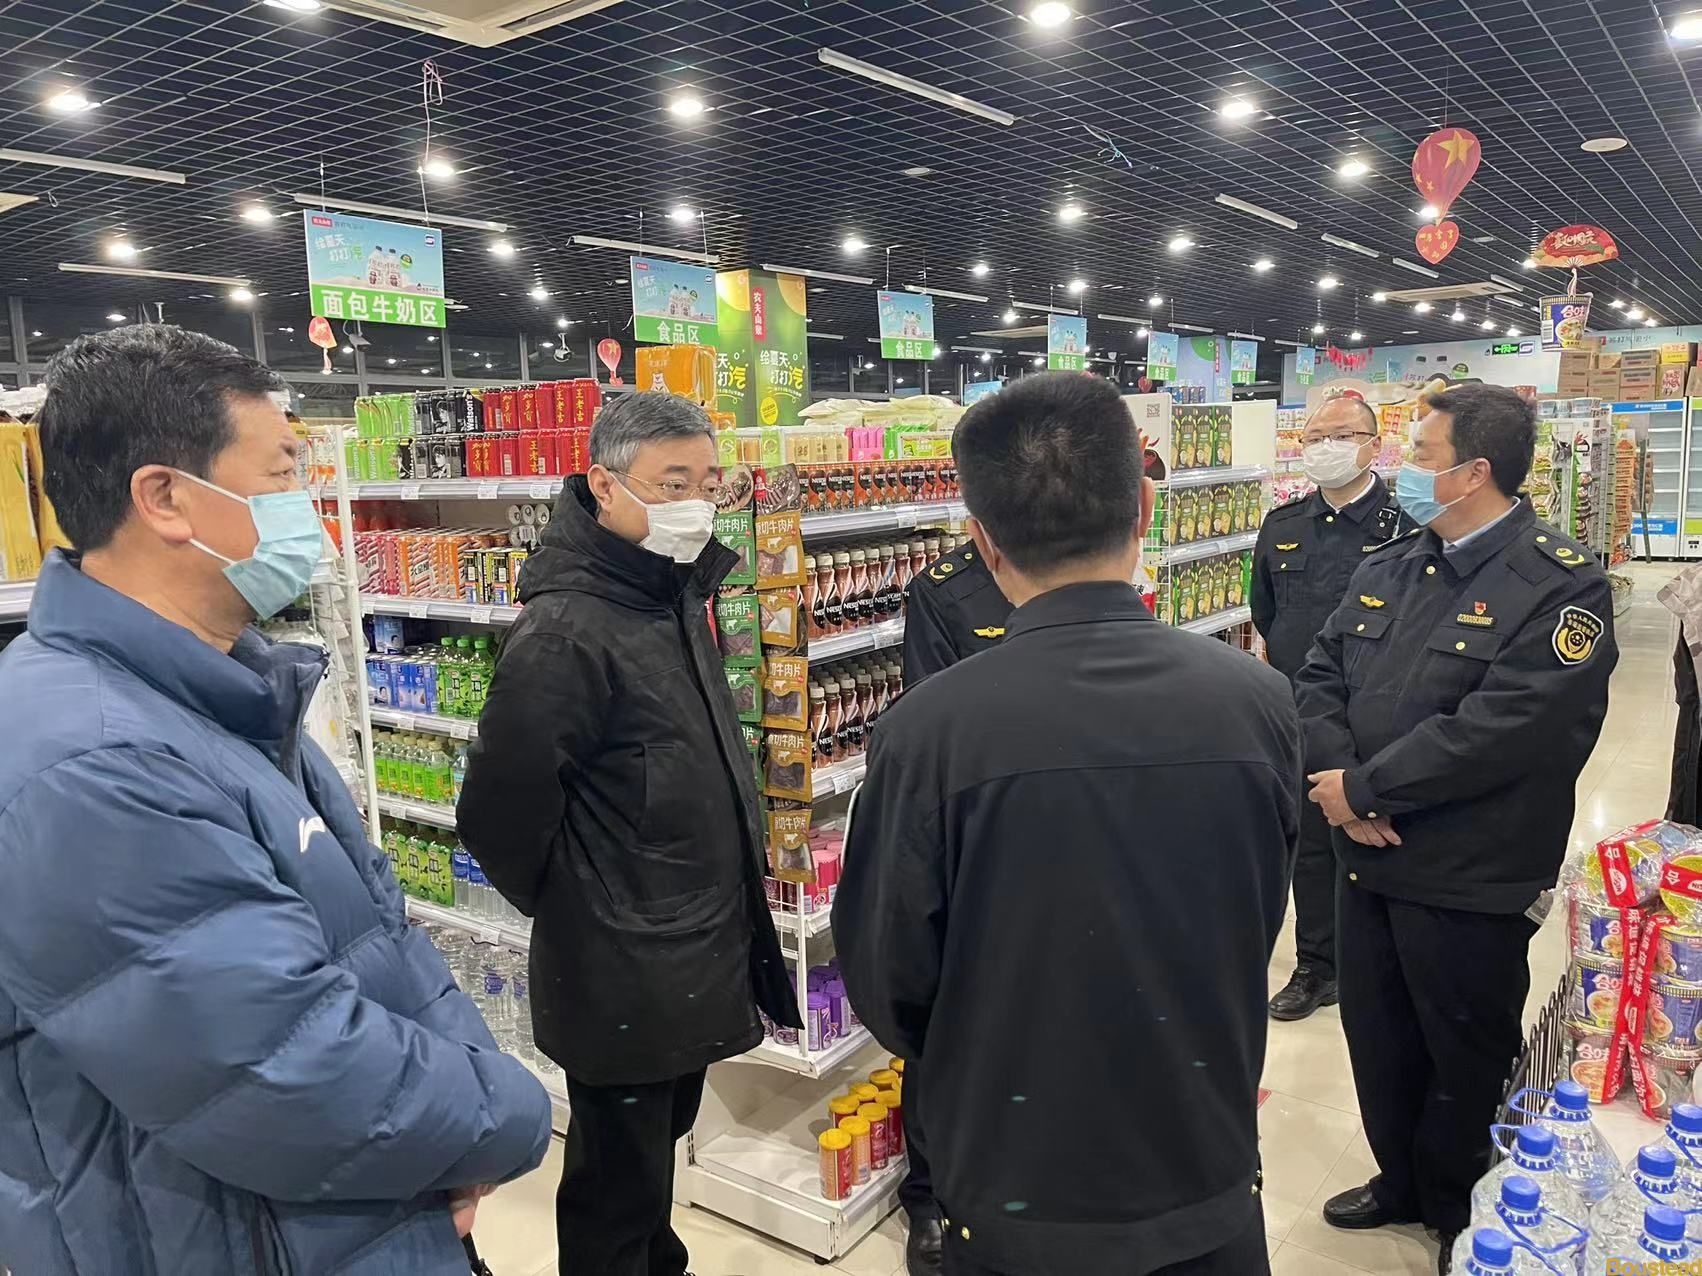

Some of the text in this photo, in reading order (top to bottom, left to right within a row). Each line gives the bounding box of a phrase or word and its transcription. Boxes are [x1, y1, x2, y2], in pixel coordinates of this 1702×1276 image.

[321, 289, 438, 325] 面包牛奶区
[753, 292, 762, 336] 农夫山泉
[657, 321, 700, 345] 食品区
[896, 340, 923, 359] 食品区
[760, 350, 788, 368] 给夏天
[716, 366, 746, 390] 打汽
[465, 394, 475, 431] Watson's
[556, 390, 565, 423] 王老吉
[576, 388, 585, 422] 王老吉
[529, 440, 539, 473] 王老吉
[769, 662, 802, 679] 切牛肉片
